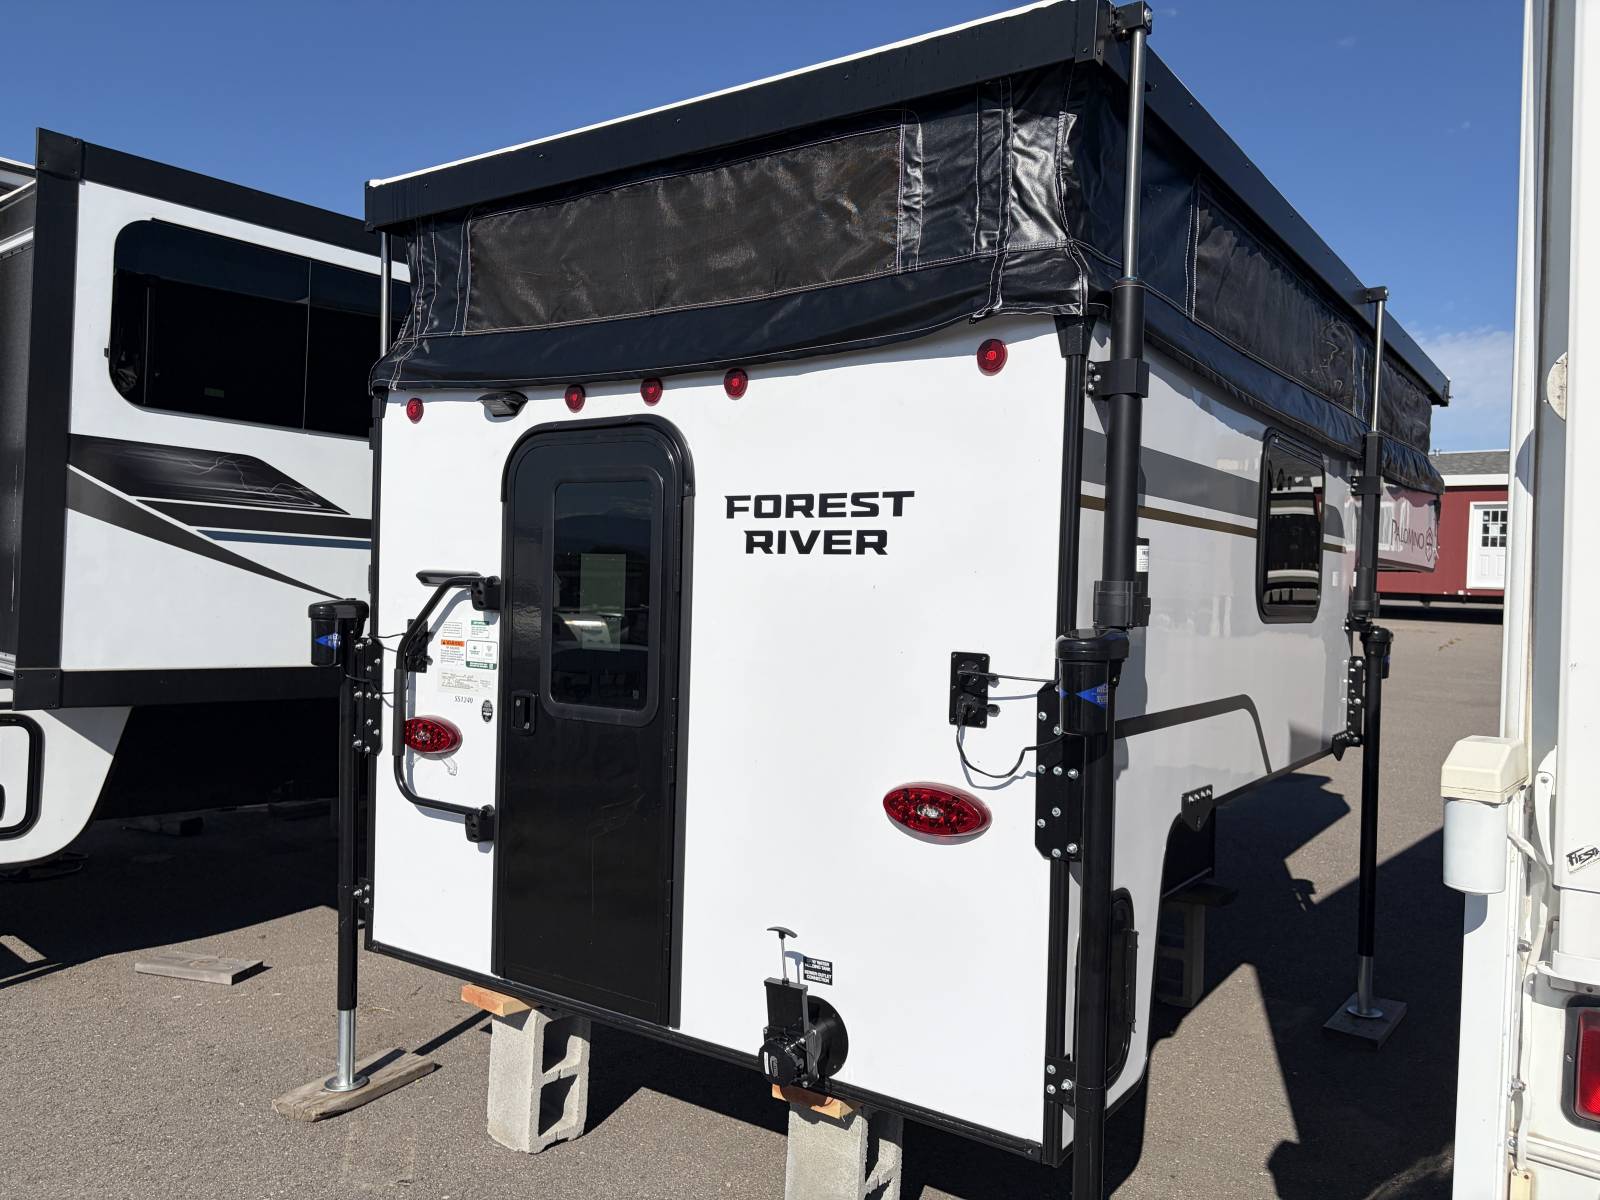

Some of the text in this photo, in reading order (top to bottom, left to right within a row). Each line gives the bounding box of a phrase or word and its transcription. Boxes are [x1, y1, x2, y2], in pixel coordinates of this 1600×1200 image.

[724, 490, 915, 519] FOREST
[743, 529, 888, 556] RIVER
[1390, 519, 1425, 552] PALOMINO
